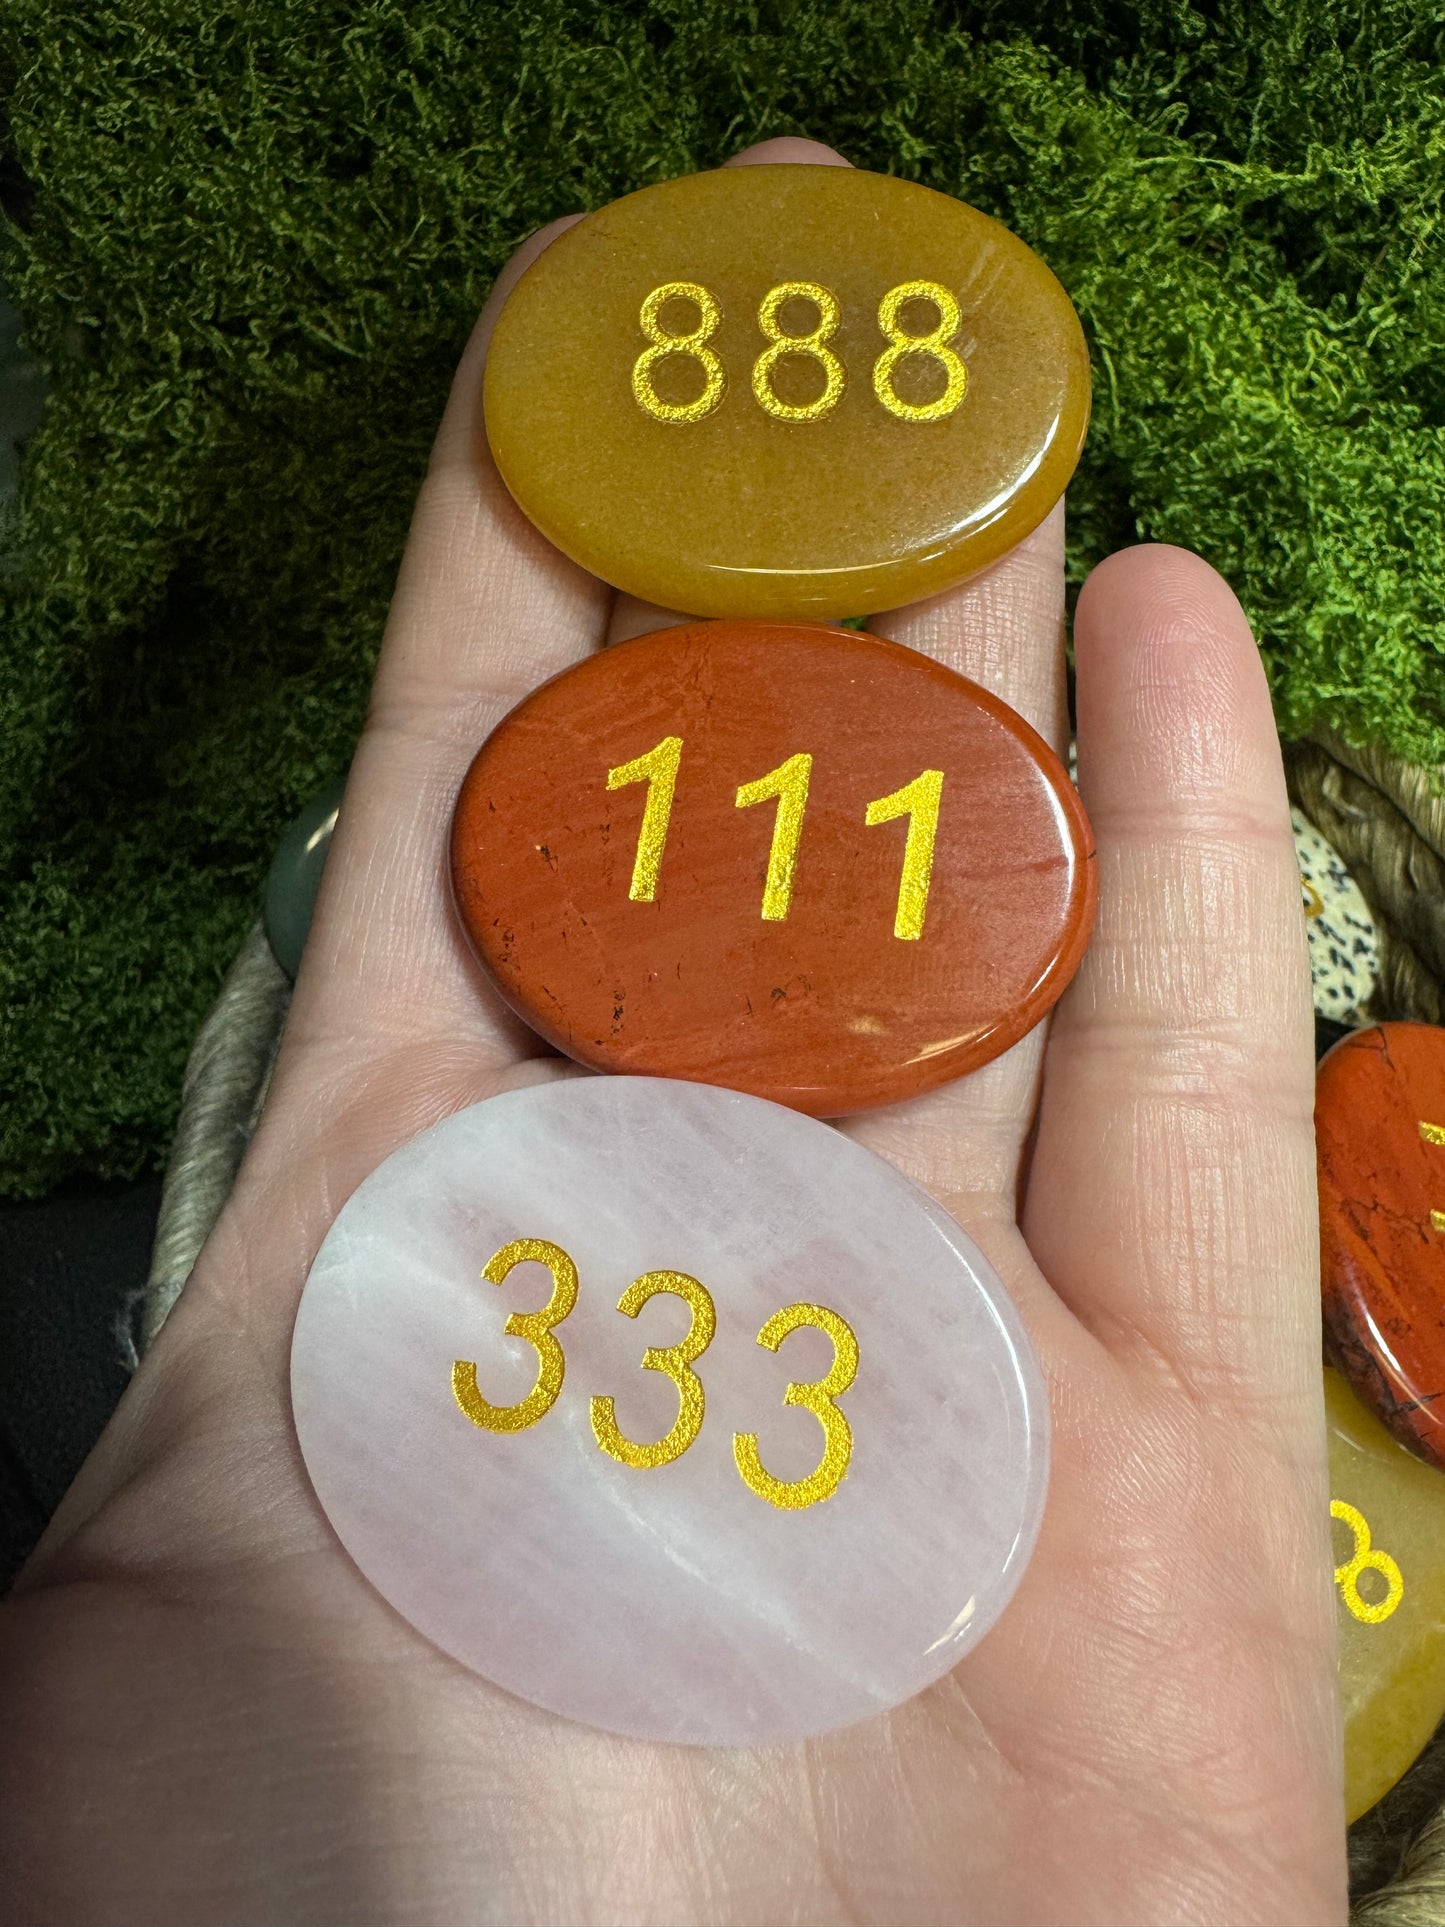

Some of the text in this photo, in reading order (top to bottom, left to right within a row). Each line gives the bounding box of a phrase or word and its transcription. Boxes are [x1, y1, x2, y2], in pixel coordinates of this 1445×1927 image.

[630, 280, 971, 424] 888
[606, 736, 945, 943] 111
[451, 1239, 860, 1511] 333
